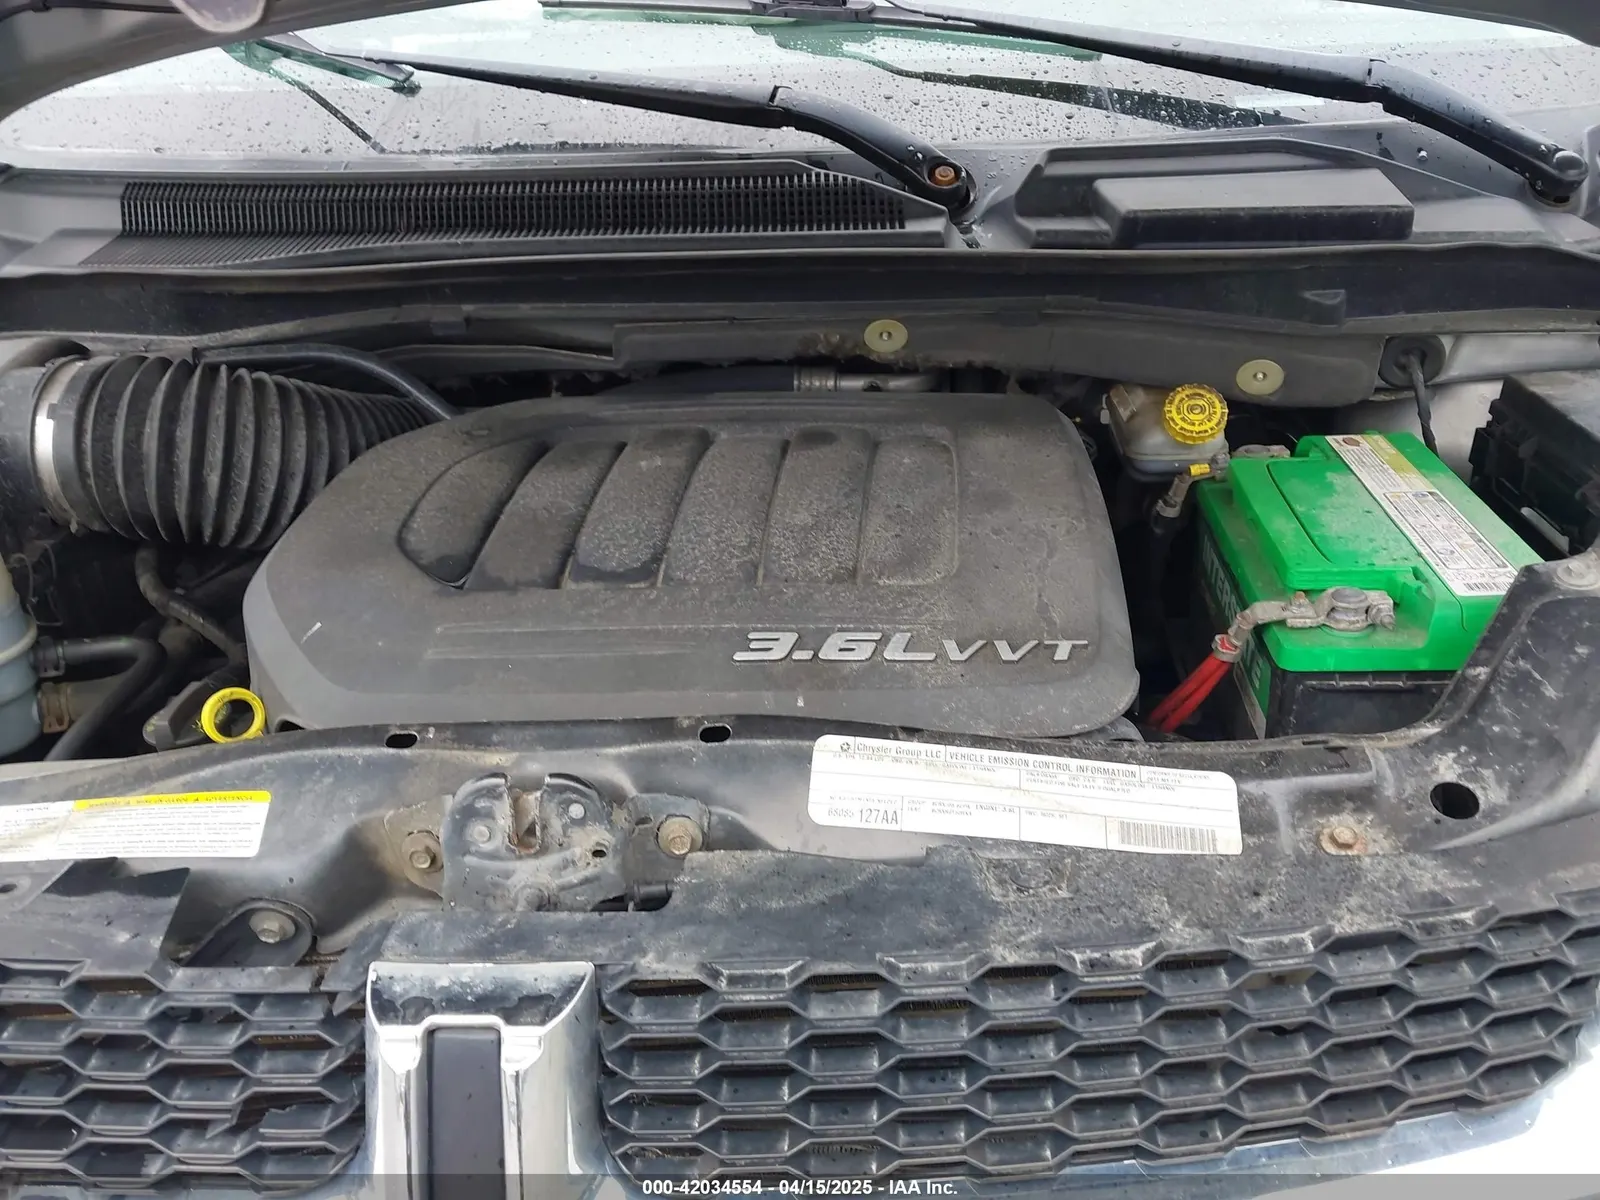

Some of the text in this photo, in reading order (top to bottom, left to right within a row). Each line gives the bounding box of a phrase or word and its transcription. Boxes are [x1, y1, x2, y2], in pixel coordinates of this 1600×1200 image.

[732, 631, 1090, 663] 3.6L VVT
[856, 742, 893, 756] Chrysler
[895, 745, 922, 760] Group
[925, 749, 942, 759] LLC
[949, 751, 985, 764] VEHICLE
[988, 755, 1030, 768] EMISSION
[1032, 760, 1073, 773] CONTROL
[1076, 765, 1137, 779] INFORMATION
[859, 808, 899, 825] 127AA
